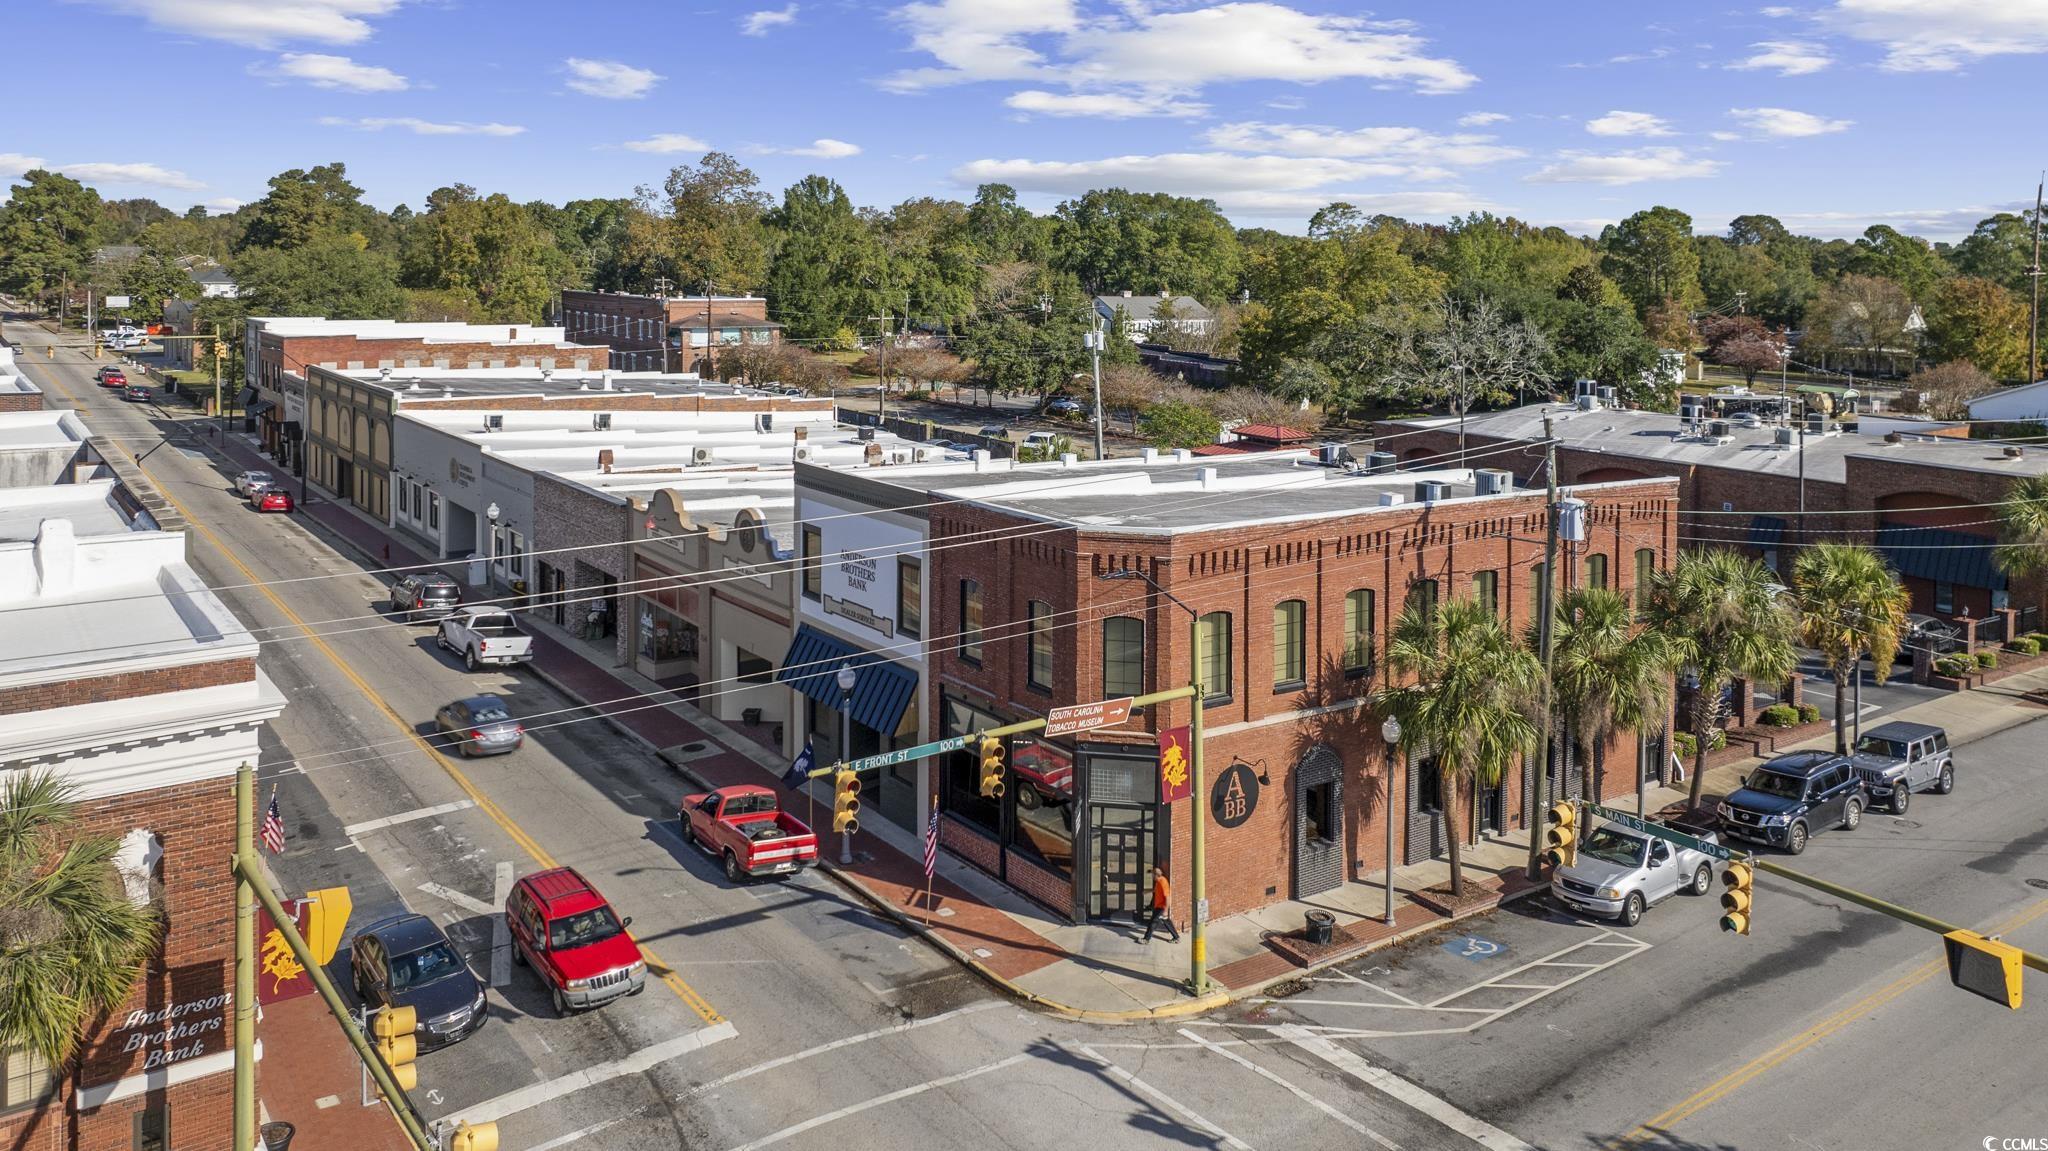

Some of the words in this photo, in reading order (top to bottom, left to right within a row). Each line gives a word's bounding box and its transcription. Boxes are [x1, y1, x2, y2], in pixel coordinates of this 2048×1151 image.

[840, 549, 877, 570] ANDERSON
[840, 561, 876, 582] BROTHERS
[848, 575, 867, 592] BANK
[1051, 709, 1072, 720] SOUTH
[1073, 705, 1103, 717] CAROLINA
[1048, 721, 1076, 733] TOBACCO
[1077, 716, 1104, 728] MUSEUM
[940, 741, 954, 752] 100
[855, 761, 862, 771] E
[865, 754, 893, 769] FRONT
[897, 750, 909, 761] ST
[1224, 771, 1246, 801] A
[1224, 798, 1247, 820] BB
[1594, 807, 1601, 816] S
[1605, 810, 1631, 827] MAIN
[1634, 820, 1647, 832] ST
[1696, 841, 1716, 854] 100
[113, 992, 232, 1033] Anderson
[122, 1016, 222, 1053] Brothers
[143, 1039, 204, 1070] Bank
